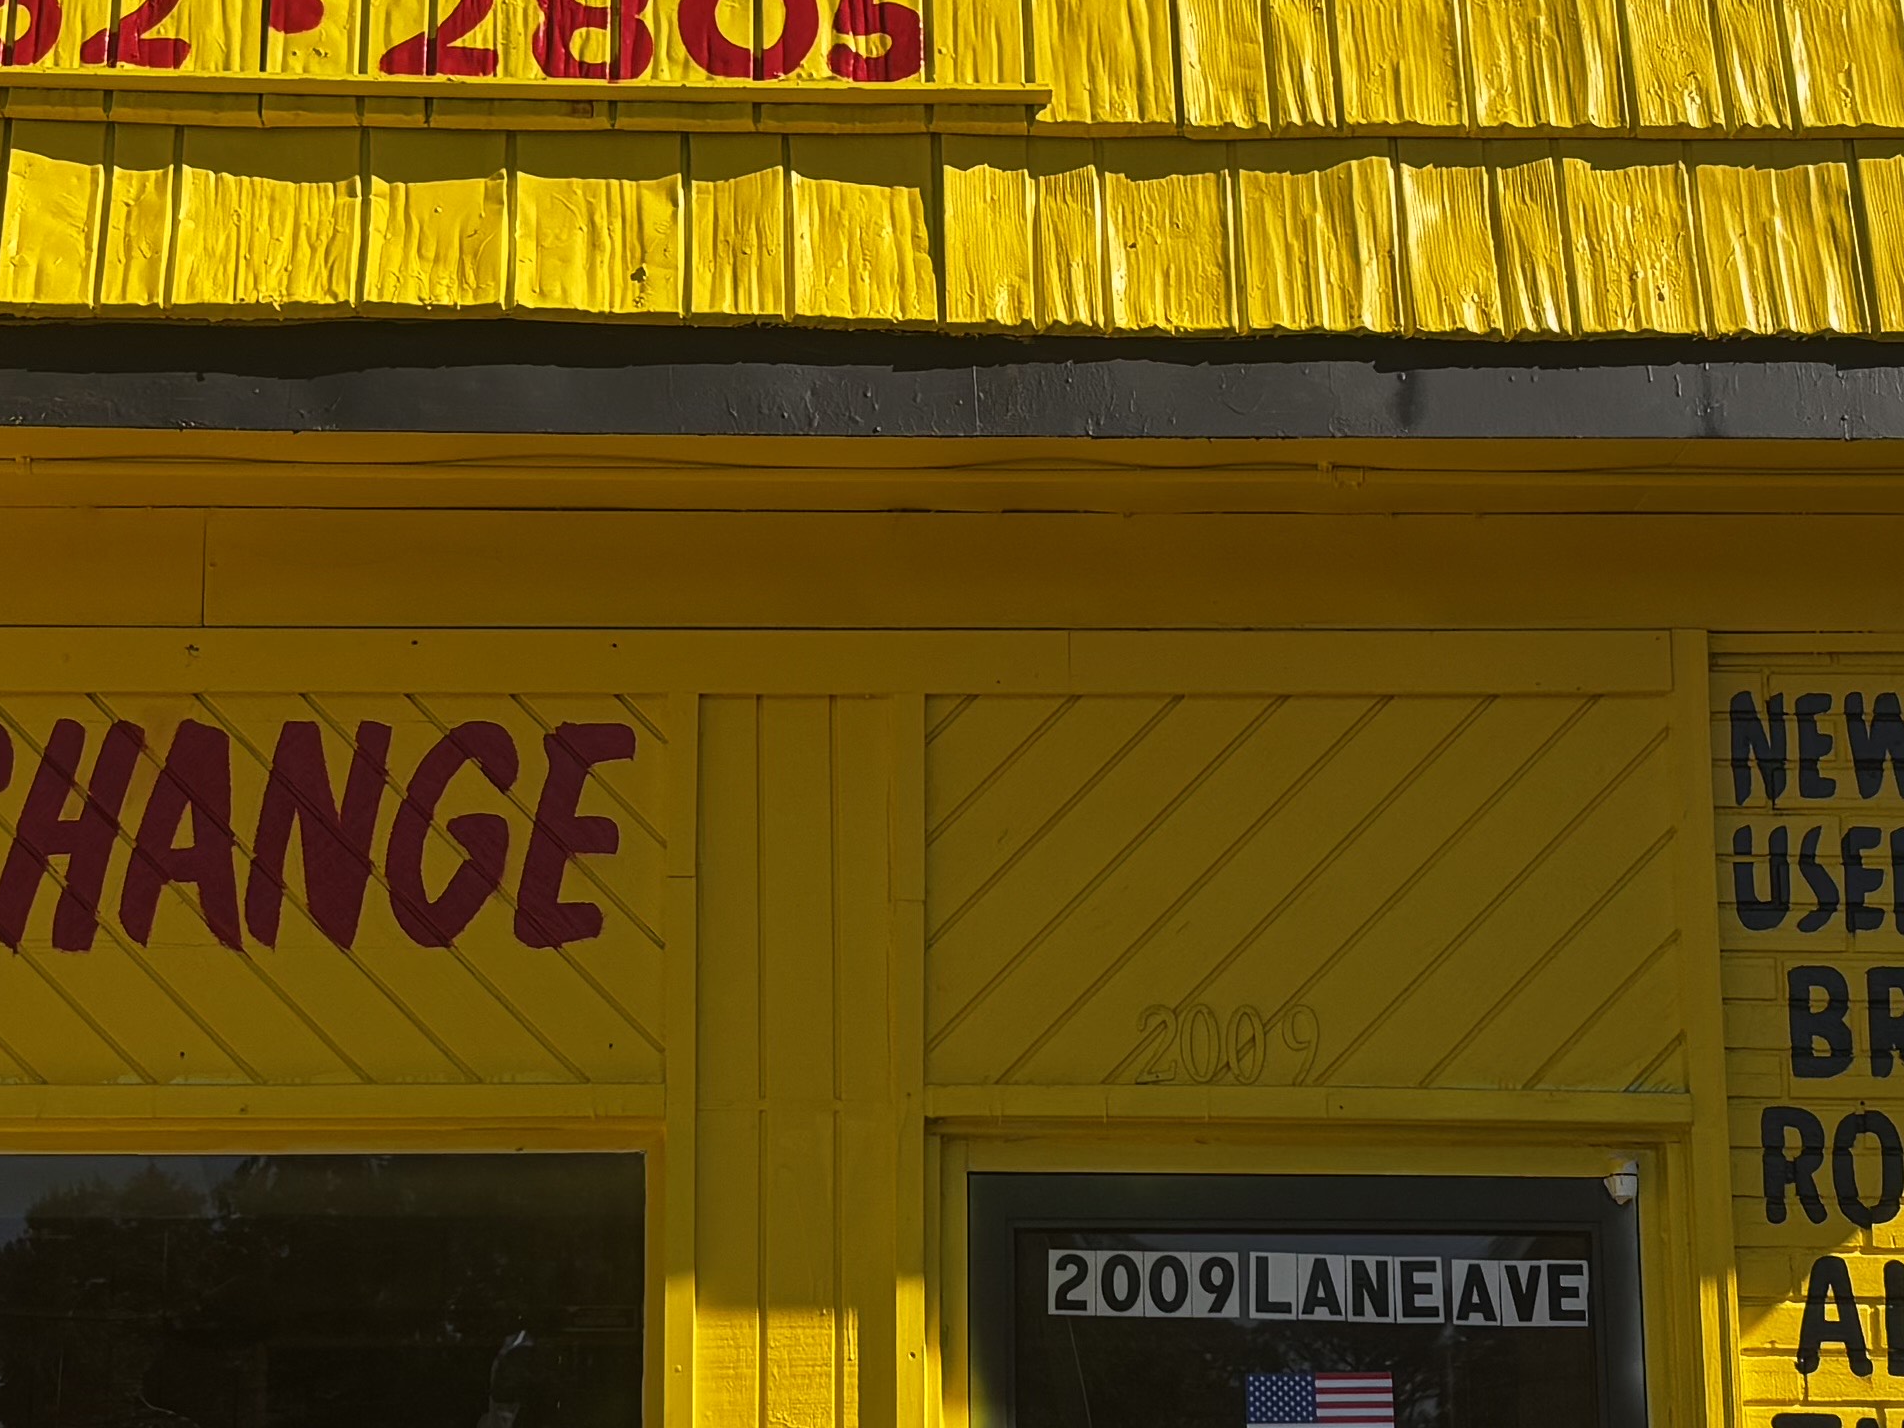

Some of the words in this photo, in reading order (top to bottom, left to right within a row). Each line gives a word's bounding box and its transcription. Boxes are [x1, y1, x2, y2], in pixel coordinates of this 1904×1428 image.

[1053, 1253, 1236, 1314] 2009
[1253, 1257, 1441, 1319] LANE
[1456, 1263, 1588, 1323] AVE
